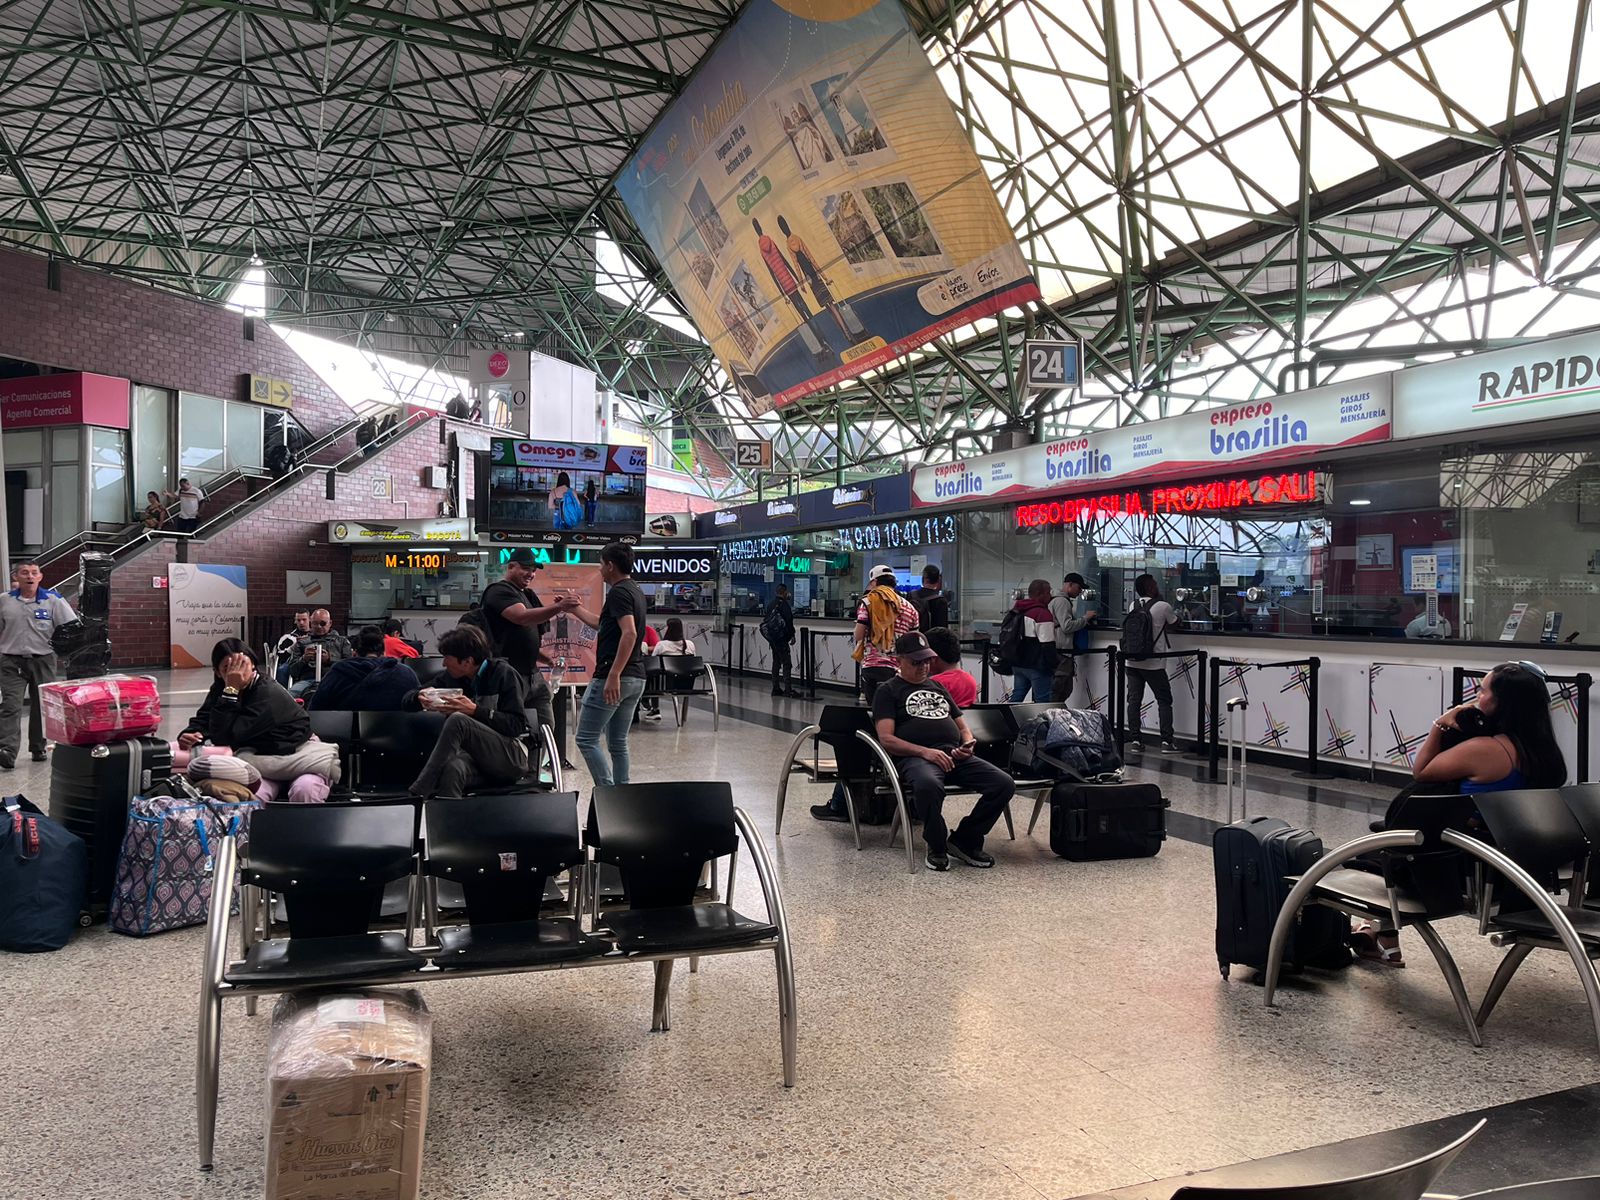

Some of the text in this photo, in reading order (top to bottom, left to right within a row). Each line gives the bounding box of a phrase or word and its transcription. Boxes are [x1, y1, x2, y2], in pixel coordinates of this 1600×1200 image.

[1031, 349, 1064, 379] 24
[1478, 355, 1600, 402] RAPID
[11, 389, 72, 403] Comunicaciones
[1340, 392, 1371, 405] PASAJES
[6, 405, 73, 421] Agente Comercial
[1210, 402, 1273, 426] expreso
[1340, 402, 1363, 415] GIROS
[1340, 408, 1387, 424] MENSAJERÍA
[1133, 434, 1153, 444] PASAJES
[1210, 414, 1308, 455] brasilia
[518, 443, 576, 459] Omega
[740, 445, 761, 463] 25
[1046, 438, 1089, 458] expreso
[1133, 443, 1149, 451] GIROS
[934, 463, 966, 478] expreso
[1046, 449, 1112, 481] brasilia
[373, 481, 386, 497] 28
[934, 472, 983, 497] brasilia
[1152, 479, 1254, 513] PROXIMA
[855, 525, 881, 550] 9:00
[884, 520, 920, 547] 10:40
[407, 554, 440, 568] 11:00
[631, 558, 711, 574] NVENIDOS
